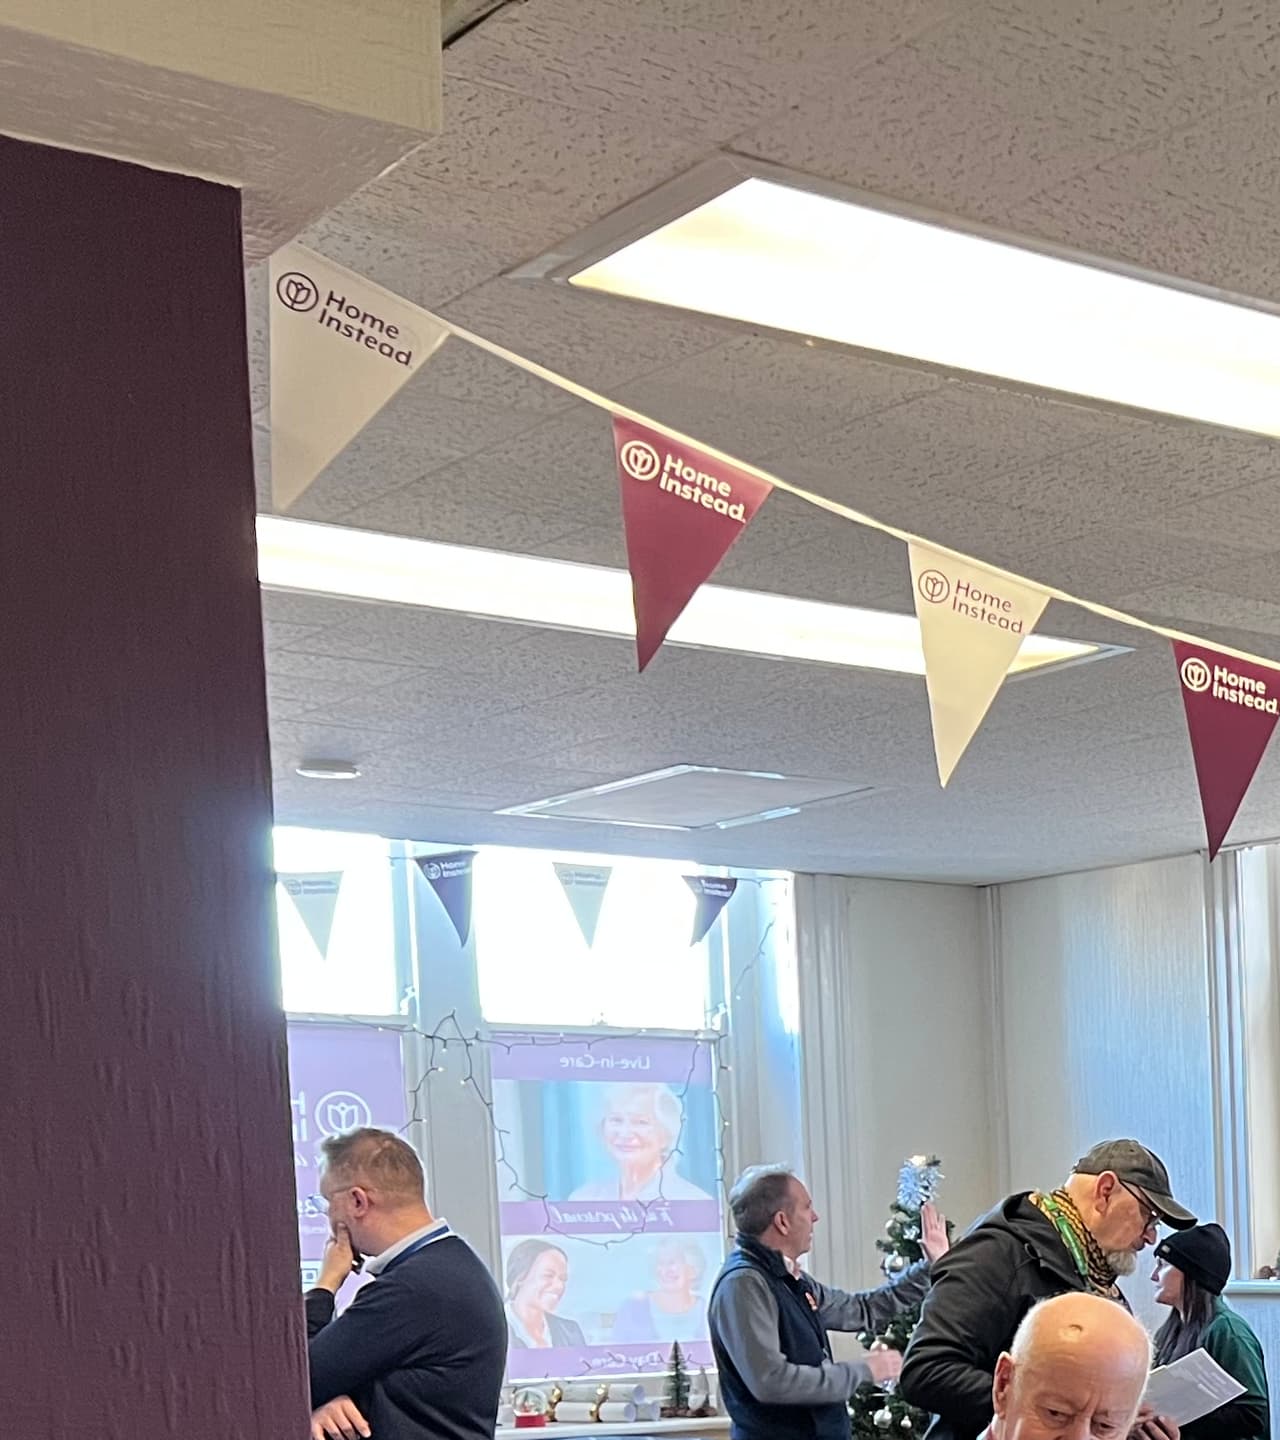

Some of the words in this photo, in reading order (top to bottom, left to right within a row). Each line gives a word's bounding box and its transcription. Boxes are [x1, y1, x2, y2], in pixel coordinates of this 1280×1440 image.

[326, 290, 399, 339] Home
[318, 309, 412, 366] Instead
[664, 454, 731, 497] Home
[953, 596, 1023, 633] Instead
[956, 580, 1012, 612] Home
[1214, 665, 1266, 694] Home
